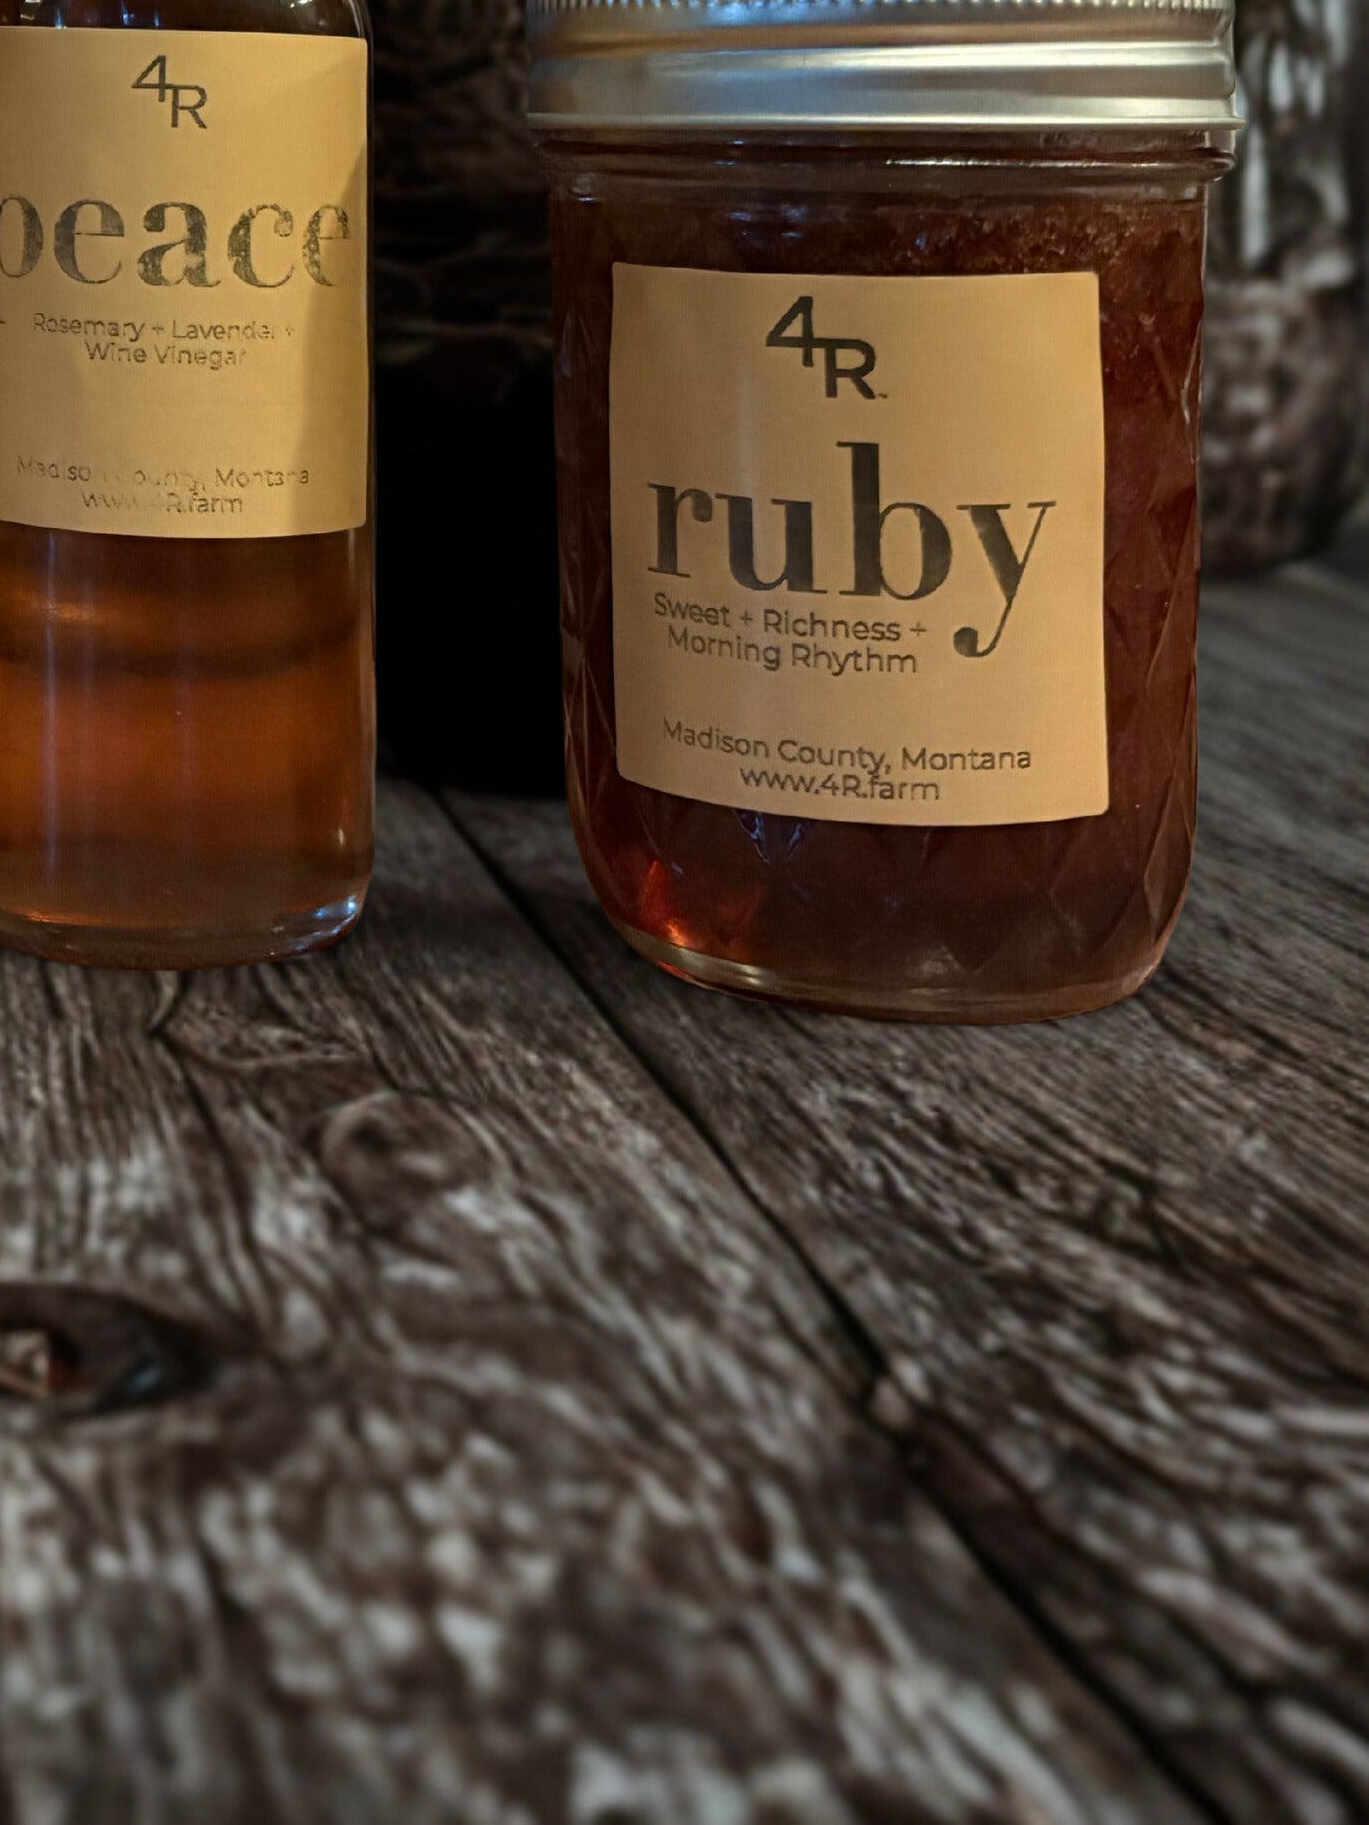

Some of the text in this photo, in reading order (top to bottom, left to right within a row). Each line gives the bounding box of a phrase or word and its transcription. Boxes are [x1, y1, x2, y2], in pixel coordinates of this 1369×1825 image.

[132, 55, 207, 129] 4R
[33, 313, 145, 342] Rosemary
[85, 342, 247, 370] Wine Vinegar
[16, 455, 108, 482] Madso
[647, 441, 1056, 658] ruby
[654, 592, 927, 641] Sweet + Richness +
[667, 625, 917, 676] Morning Rhythm
[663, 717, 1031, 774] Madison County, Montana
[740, 766, 941, 801] www.4R.farm
